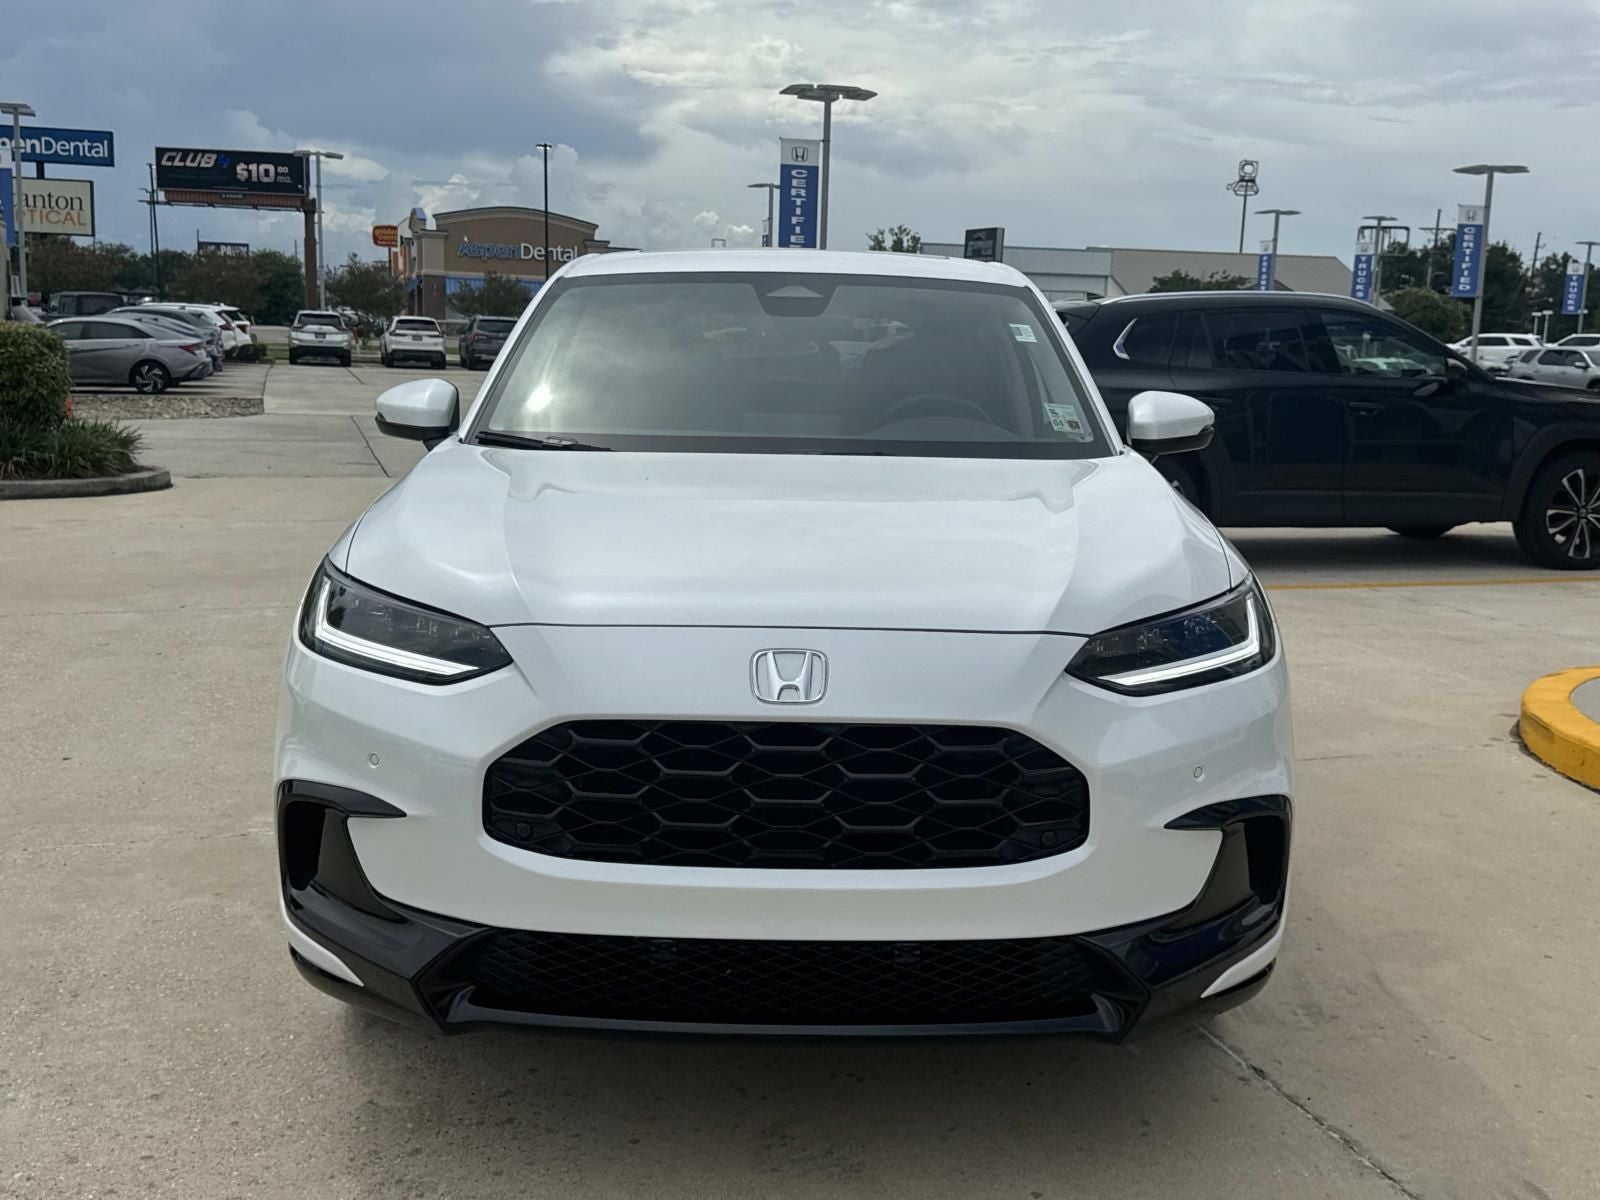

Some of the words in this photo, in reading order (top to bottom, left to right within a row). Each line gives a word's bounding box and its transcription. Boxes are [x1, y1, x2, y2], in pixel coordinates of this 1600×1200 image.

[236, 162, 275, 183] $10
[790, 169, 808, 248] CERTIFIE
[1355, 256, 1369, 298] TRUCKS
[1458, 226, 1476, 291] CERTIFIED
[1567, 275, 1578, 312] TRUCKS
